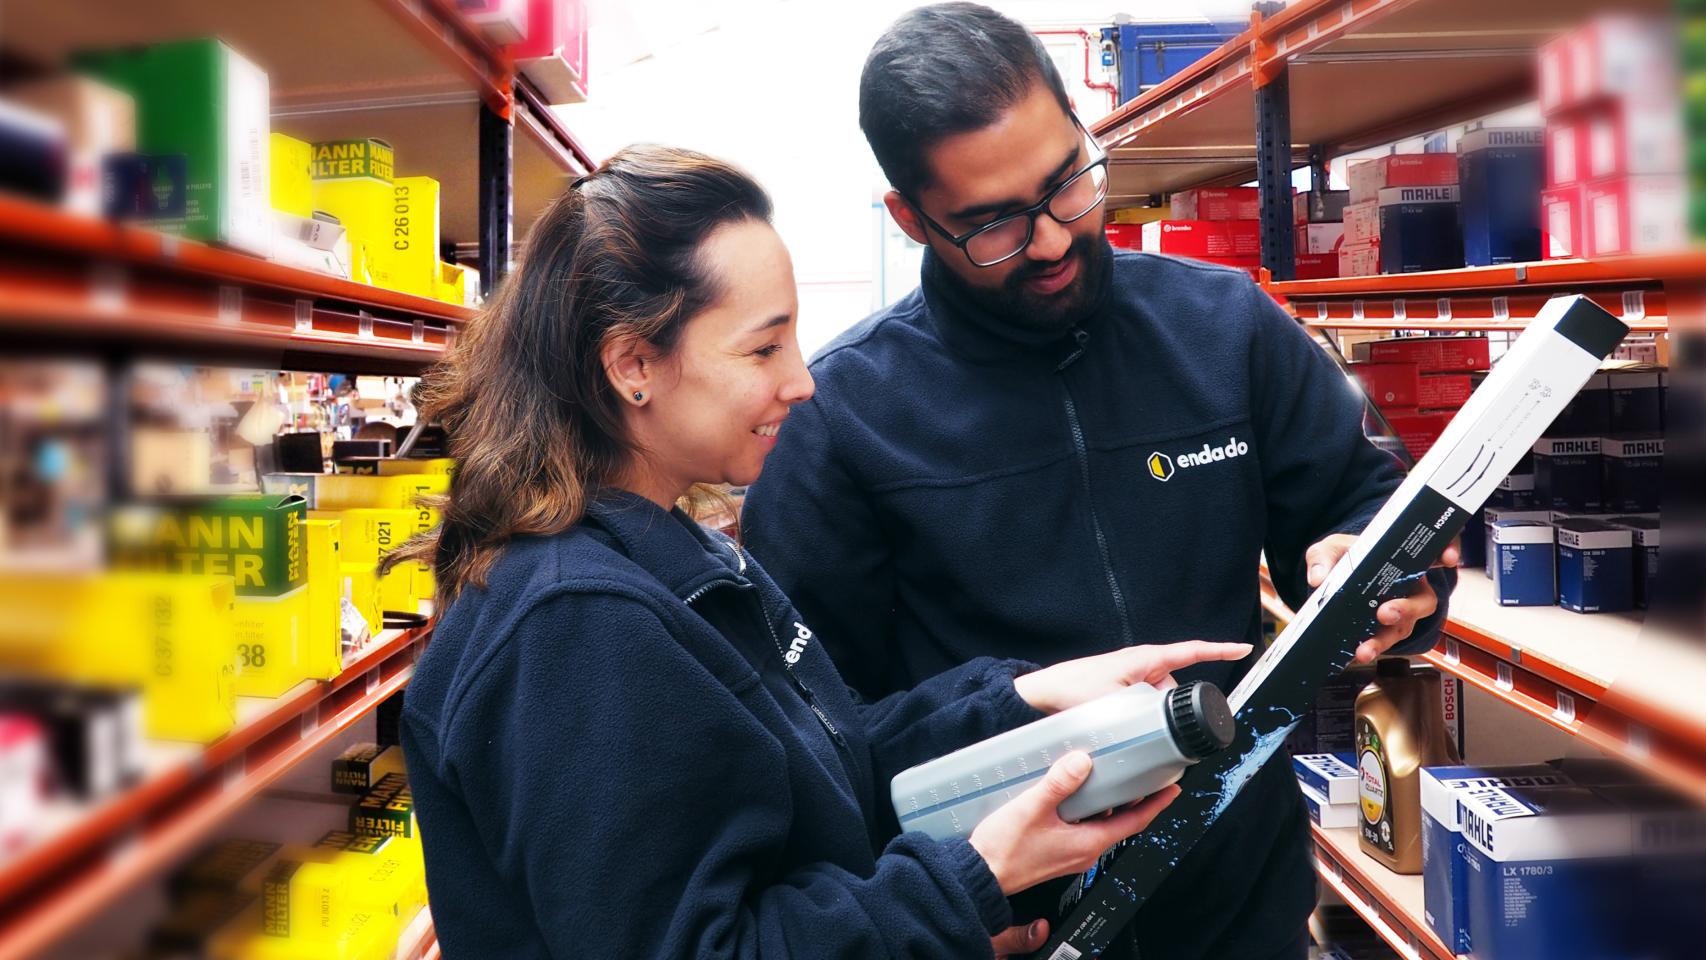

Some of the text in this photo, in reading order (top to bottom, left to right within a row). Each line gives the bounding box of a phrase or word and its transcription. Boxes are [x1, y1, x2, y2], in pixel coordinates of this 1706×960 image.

[1488, 131, 1543, 145] MAHLE
[312, 158, 365, 177] ILTER
[1401, 188, 1450, 201] MAHLE
[394, 186, 409, 250] C 26 013
[1176, 437, 1249, 468] endado
[1552, 441, 1599, 453] MAHLE
[1622, 442, 1664, 455] MAHL
[1434, 506, 1456, 530] BOSCH
[140, 515, 264, 549] ANN
[377, 520, 391, 545] 021
[785, 621, 813, 664] end
[1444, 679, 1455, 720] BOSCH
[1365, 771, 1382, 788] TOTAL
[356, 816, 405, 832] FILTER
[1457, 799, 1494, 852] MAHLE
[1503, 865, 1553, 876] LX 1780/3
[263, 882, 275, 934] MANN
[276, 883, 288, 935] FILTER
